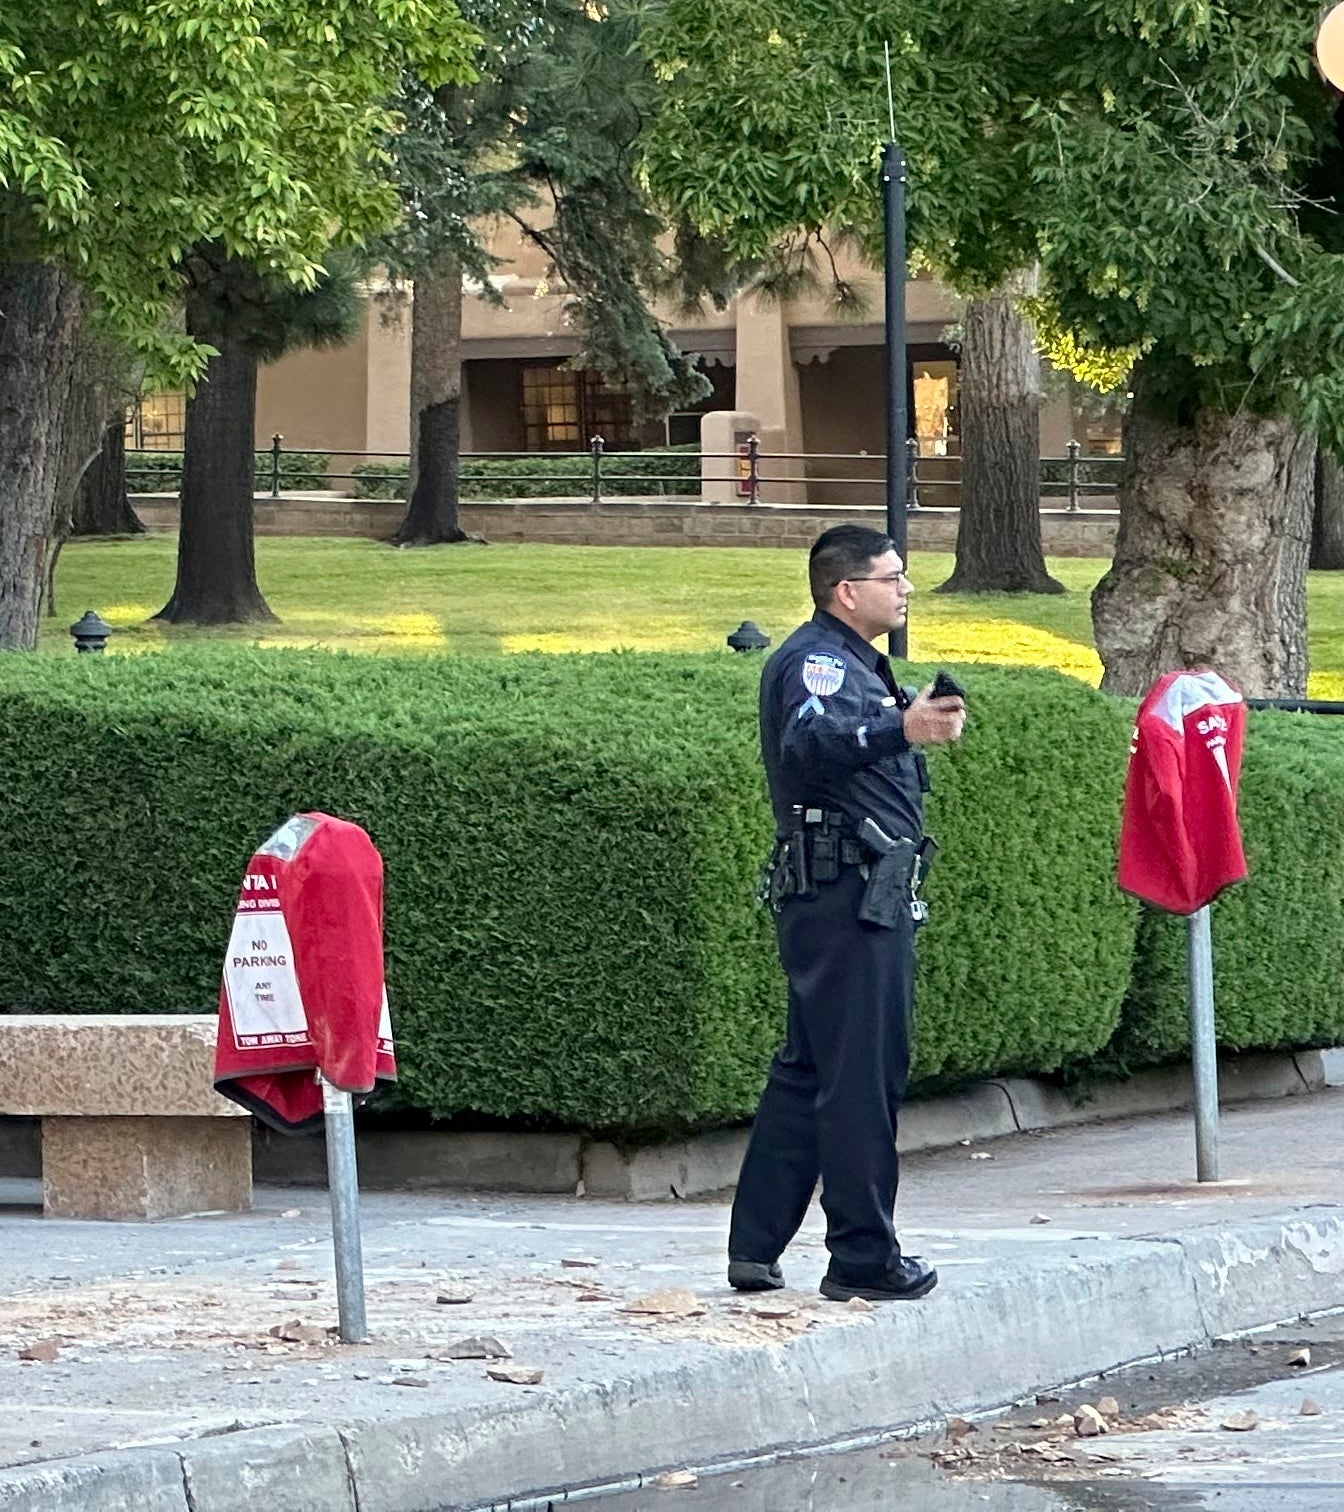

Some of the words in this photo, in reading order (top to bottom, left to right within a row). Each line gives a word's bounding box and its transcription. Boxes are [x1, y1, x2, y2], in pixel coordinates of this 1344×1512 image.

[251, 939, 268, 951] NO
[233, 955, 287, 968] PARKING
[255, 982, 272, 990] ANY
[255, 993, 275, 1002] TIME
